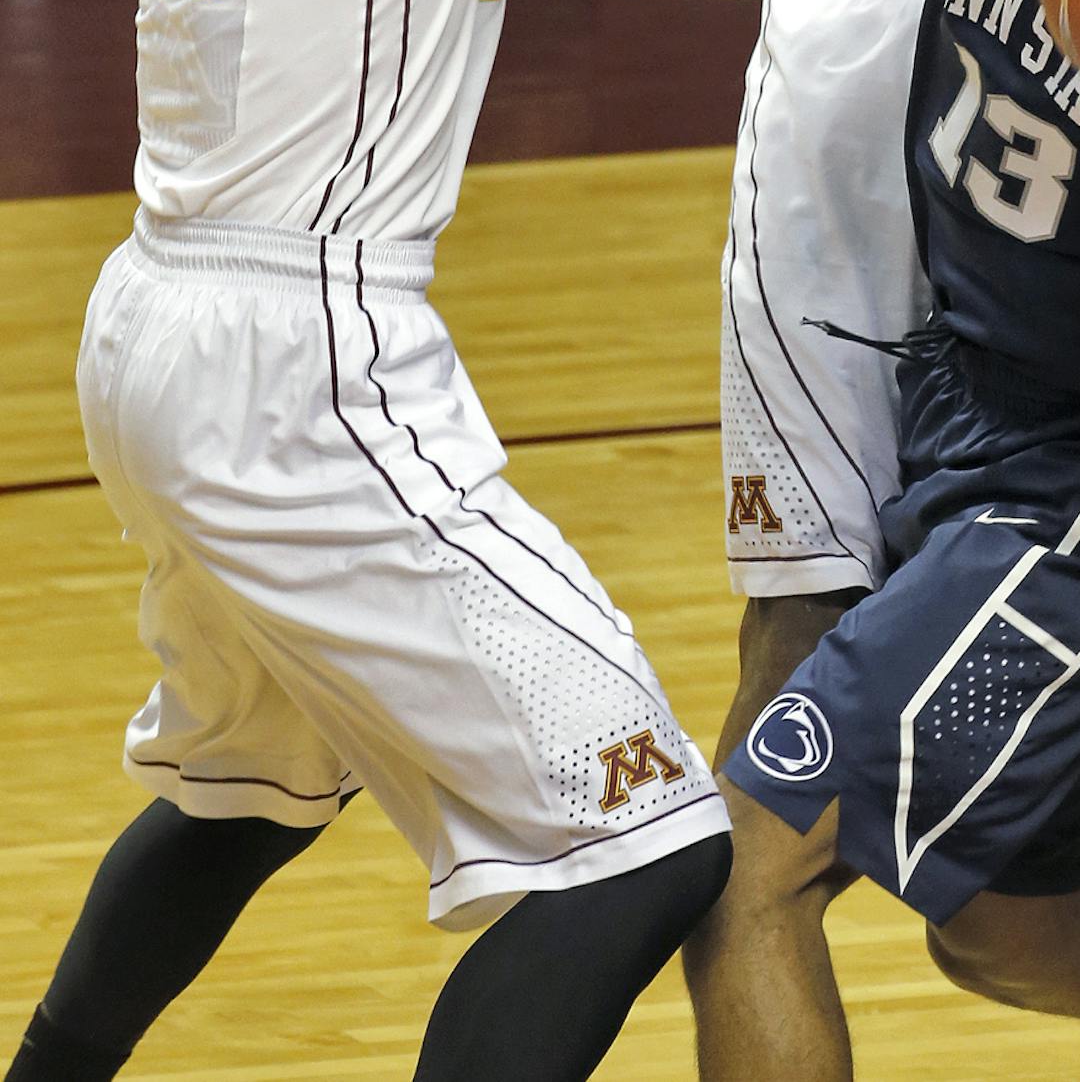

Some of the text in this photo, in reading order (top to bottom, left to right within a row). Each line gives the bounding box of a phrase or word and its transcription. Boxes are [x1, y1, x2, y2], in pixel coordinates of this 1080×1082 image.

[928, 41, 1078, 243] 13
[728, 475, 783, 534] M
[597, 729, 685, 814] M
